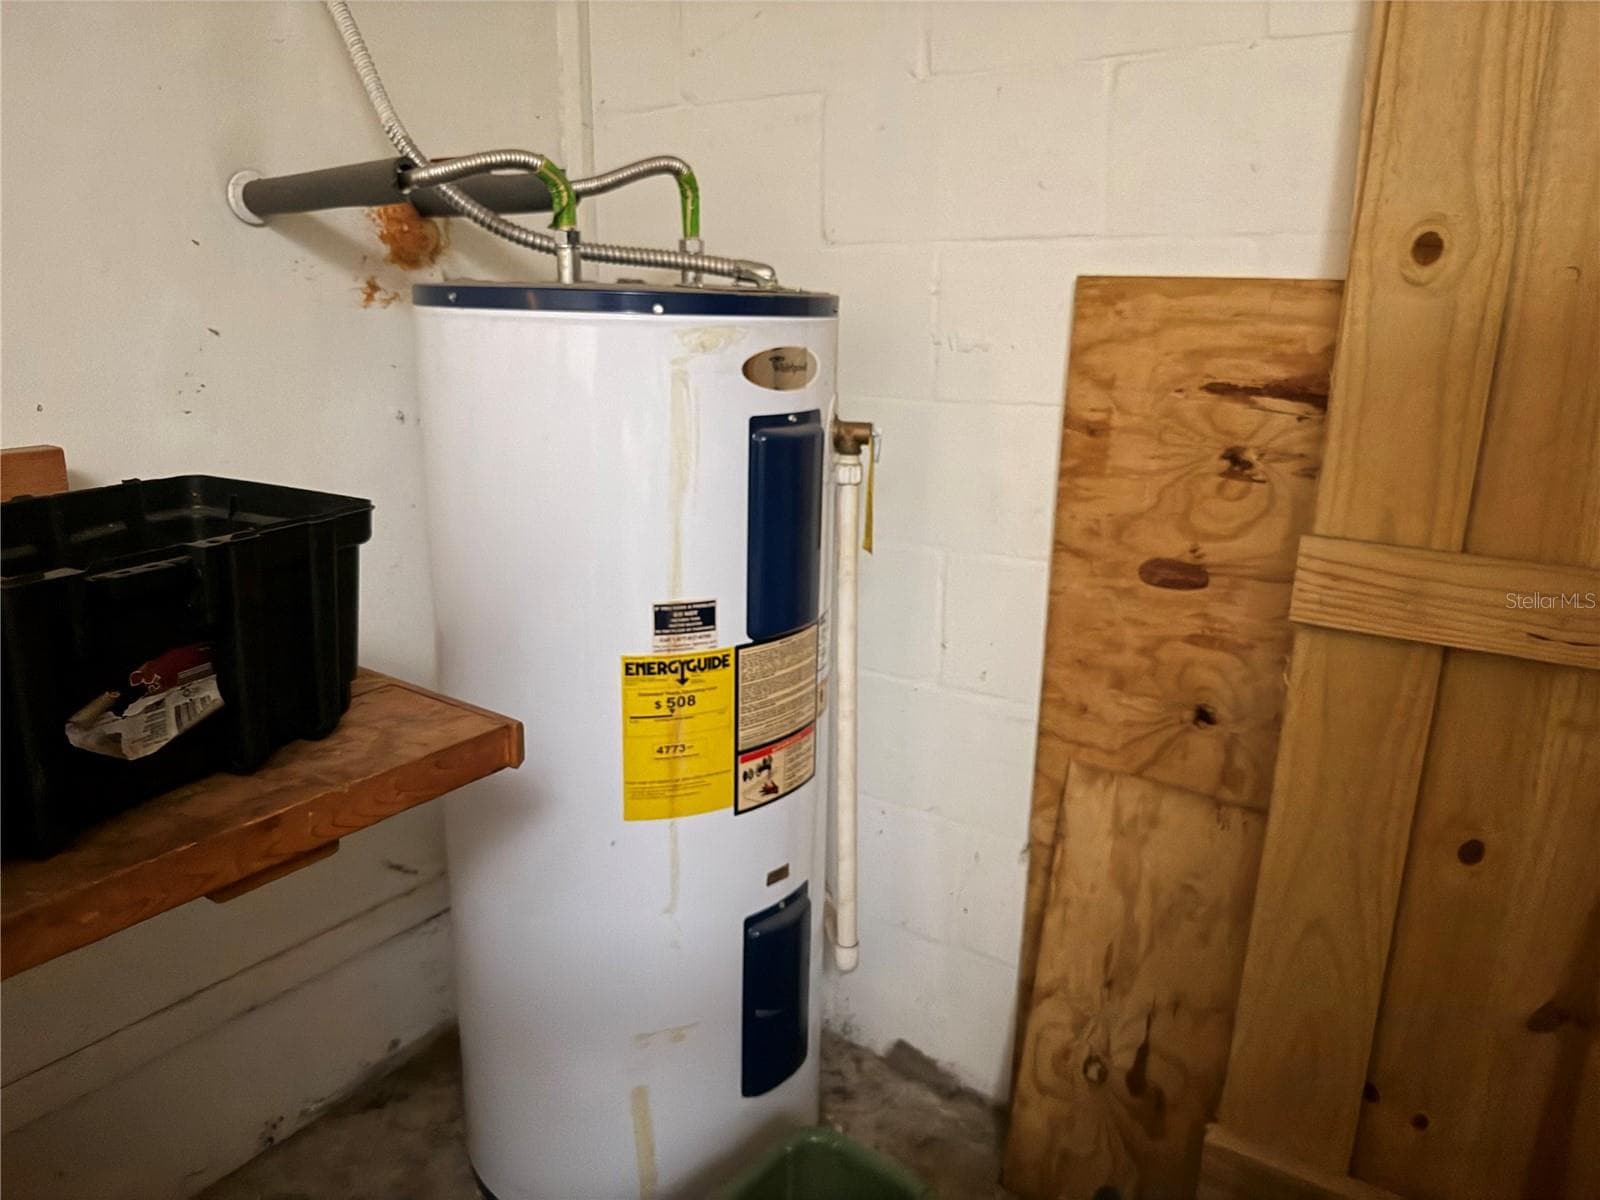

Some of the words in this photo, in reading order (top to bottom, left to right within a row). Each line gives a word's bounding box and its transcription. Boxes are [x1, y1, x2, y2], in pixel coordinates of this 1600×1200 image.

[625, 654, 730, 680] ENERGYGUIDE
[666, 694, 697, 709] 508
[656, 743, 686, 754] 4773
